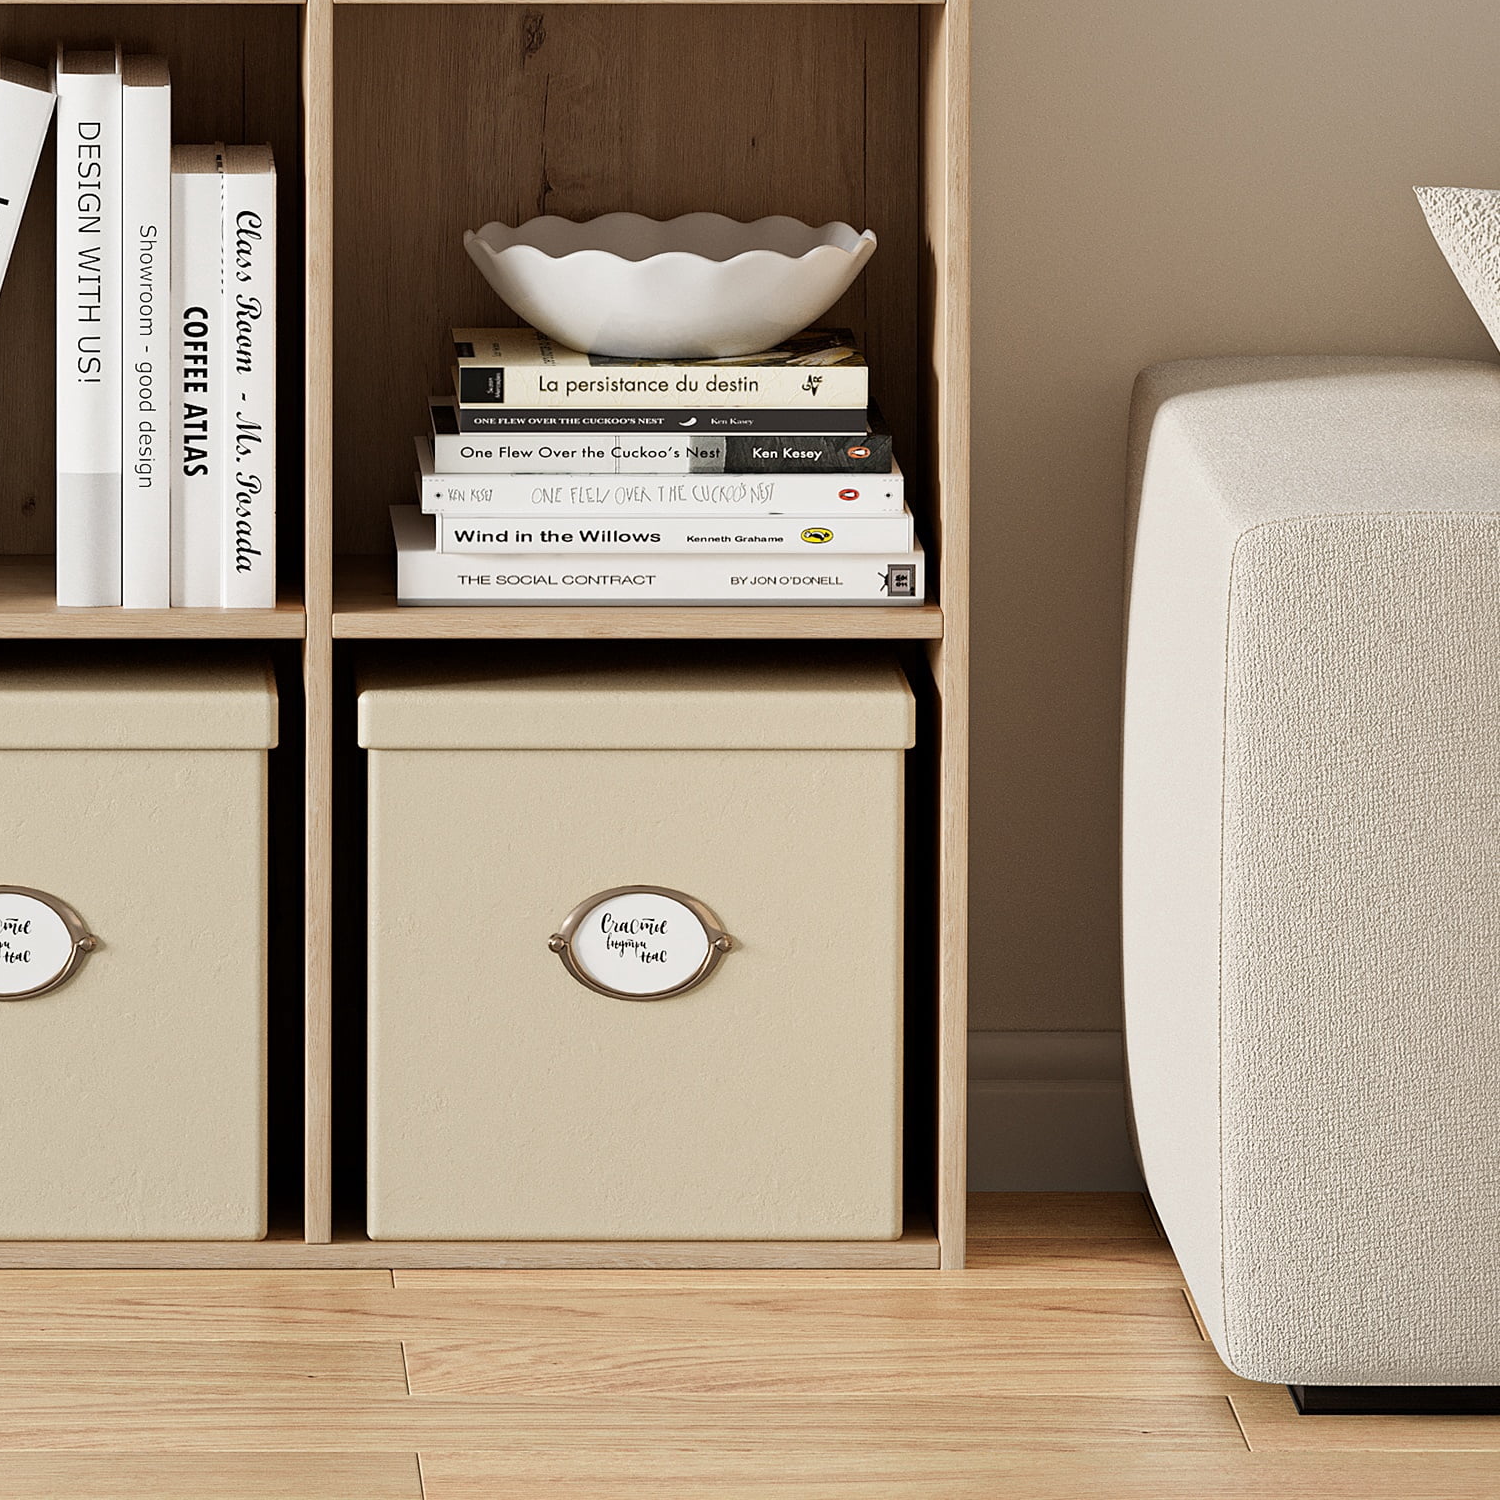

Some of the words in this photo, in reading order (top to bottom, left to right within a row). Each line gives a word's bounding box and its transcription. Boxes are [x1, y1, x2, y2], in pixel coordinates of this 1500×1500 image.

[78, 123, 101, 232] DESIGN
[236, 211, 262, 282] Class
[78, 247, 100, 321] WITH
[140, 226, 157, 335] Showroom
[236, 294, 262, 374] Room
[78, 337, 101, 382] US!
[135, 362, 156, 411] good
[134, 421, 156, 487] design
[236, 412, 262, 462] Ms.
[460, 446, 493, 460] One
[499, 445, 534, 460] Flew
[538, 446, 578, 460] Over
[581, 445, 605, 460] the
[687, 446, 721, 460] Nest
[752, 447, 778, 459] Ken
[783, 448, 822, 461] Kesey
[236, 472, 262, 573] Posada
[454, 529, 509, 543] Wind
[515, 530, 533, 543] in
[539, 529, 574, 543] the
[578, 529, 661, 543] Willows
[686, 535, 732, 543] Kenneth
[734, 535, 784, 543] Grahame
[457, 574, 492, 586] THE
[495, 574, 559, 586] SOCIAL
[561, 574, 657, 586] CONTRACT
[730, 576, 749, 586] BY
[749, 575, 777, 586] JON
